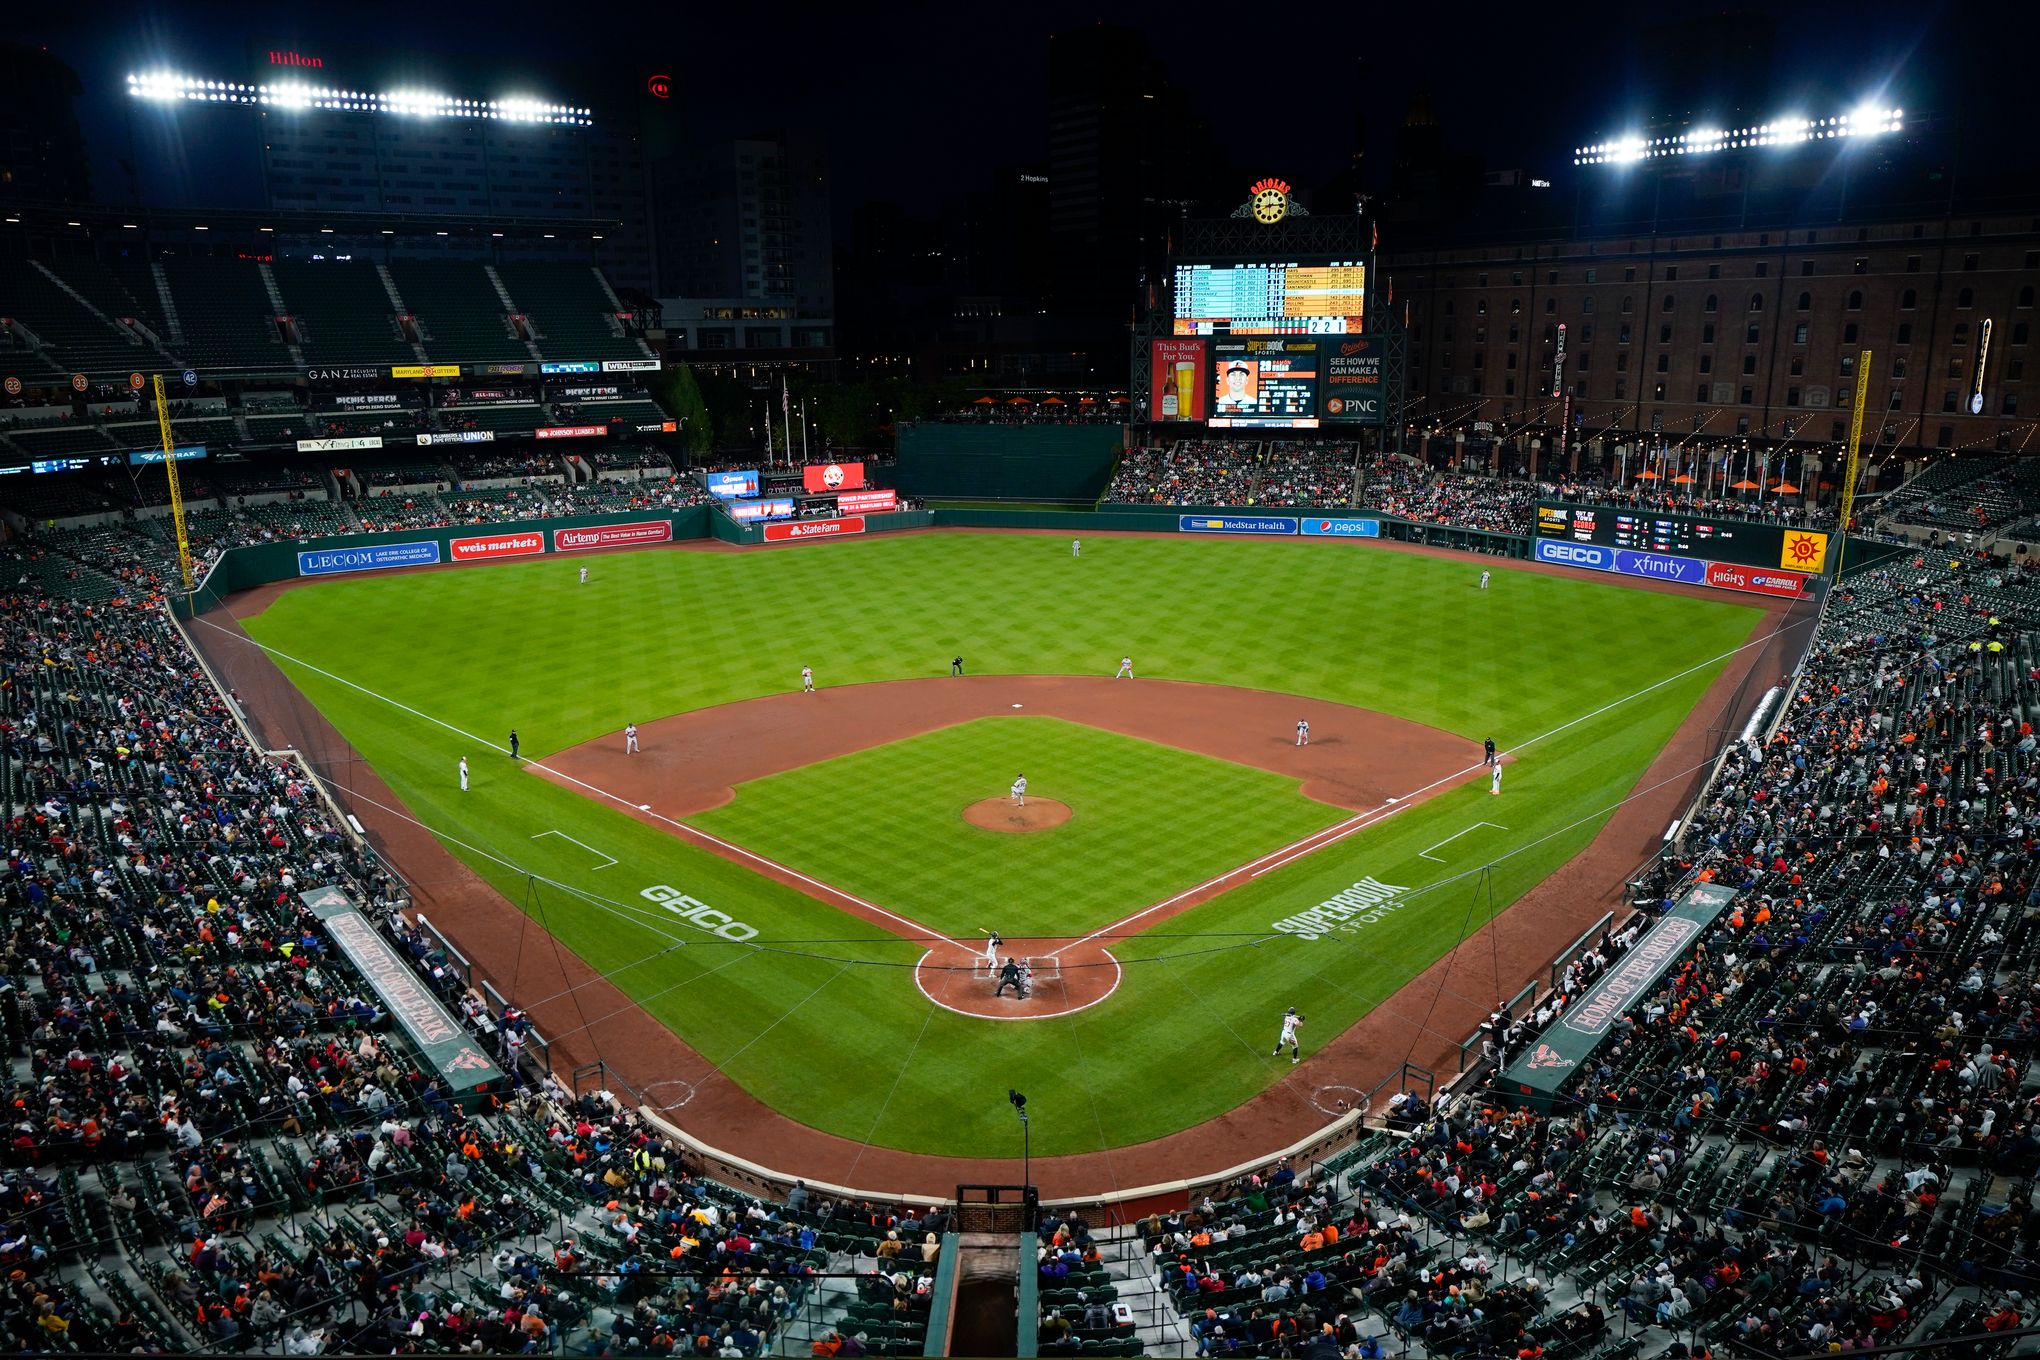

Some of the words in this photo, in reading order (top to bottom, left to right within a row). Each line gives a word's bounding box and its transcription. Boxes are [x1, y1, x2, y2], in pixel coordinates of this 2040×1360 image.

[269, 50, 324, 68] Hilton
[1250, 178, 1290, 194] ORIOLES
[1312, 322, 1318, 332] 2
[1324, 322, 1330, 332] 2
[1338, 322, 1342, 332] 1
[1247, 340, 1284, 352] SUPERBOOK
[1330, 358, 1346, 366] SEE
[1346, 358, 1366, 366] HOW
[1366, 358, 1380, 366] WE
[308, 370, 350, 380] GANZ
[1330, 366, 1347, 374] CAN
[1348, 366, 1371, 374] MAKE
[1372, 366, 1378, 374] A
[7, 380, 18, 391] 22
[75, 378, 86, 388] 33
[1329, 376, 1378, 384] DIFFERENCE
[367, 395, 397, 403] PERCH
[1344, 400, 1377, 412] PNC
[464, 431, 494, 440] UNION
[1538, 507, 1568, 520] SUPERBOOK
[1258, 522, 1285, 530] Health
[1334, 522, 1364, 532] pepsi
[1573, 520, 1596, 530] SCORES
[564, 533, 600, 543] Airtemp
[458, 543, 486, 553] weis
[488, 538, 537, 550] markets
[1543, 544, 1602, 565] GEICO
[1633, 555, 1686, 578] xfinity
[1713, 572, 1745, 587] HIGH'S
[1766, 577, 1797, 587] CARROLL
[640, 884, 760, 942] GEICO
[1272, 875, 1411, 940] SUPERBOOK
[1340, 901, 1405, 934] SPORTS
[333, 915, 381, 960] WELCOME
[368, 955, 395, 973] TO
[1573, 992, 1622, 1029] HOME
[1606, 977, 1634, 994] OF
[1621, 958, 1656, 980] THE
[1640, 920, 1690, 960] ORIOLES
[381, 972, 428, 1010] ORIOLE
[409, 1006, 452, 1041] PARK
